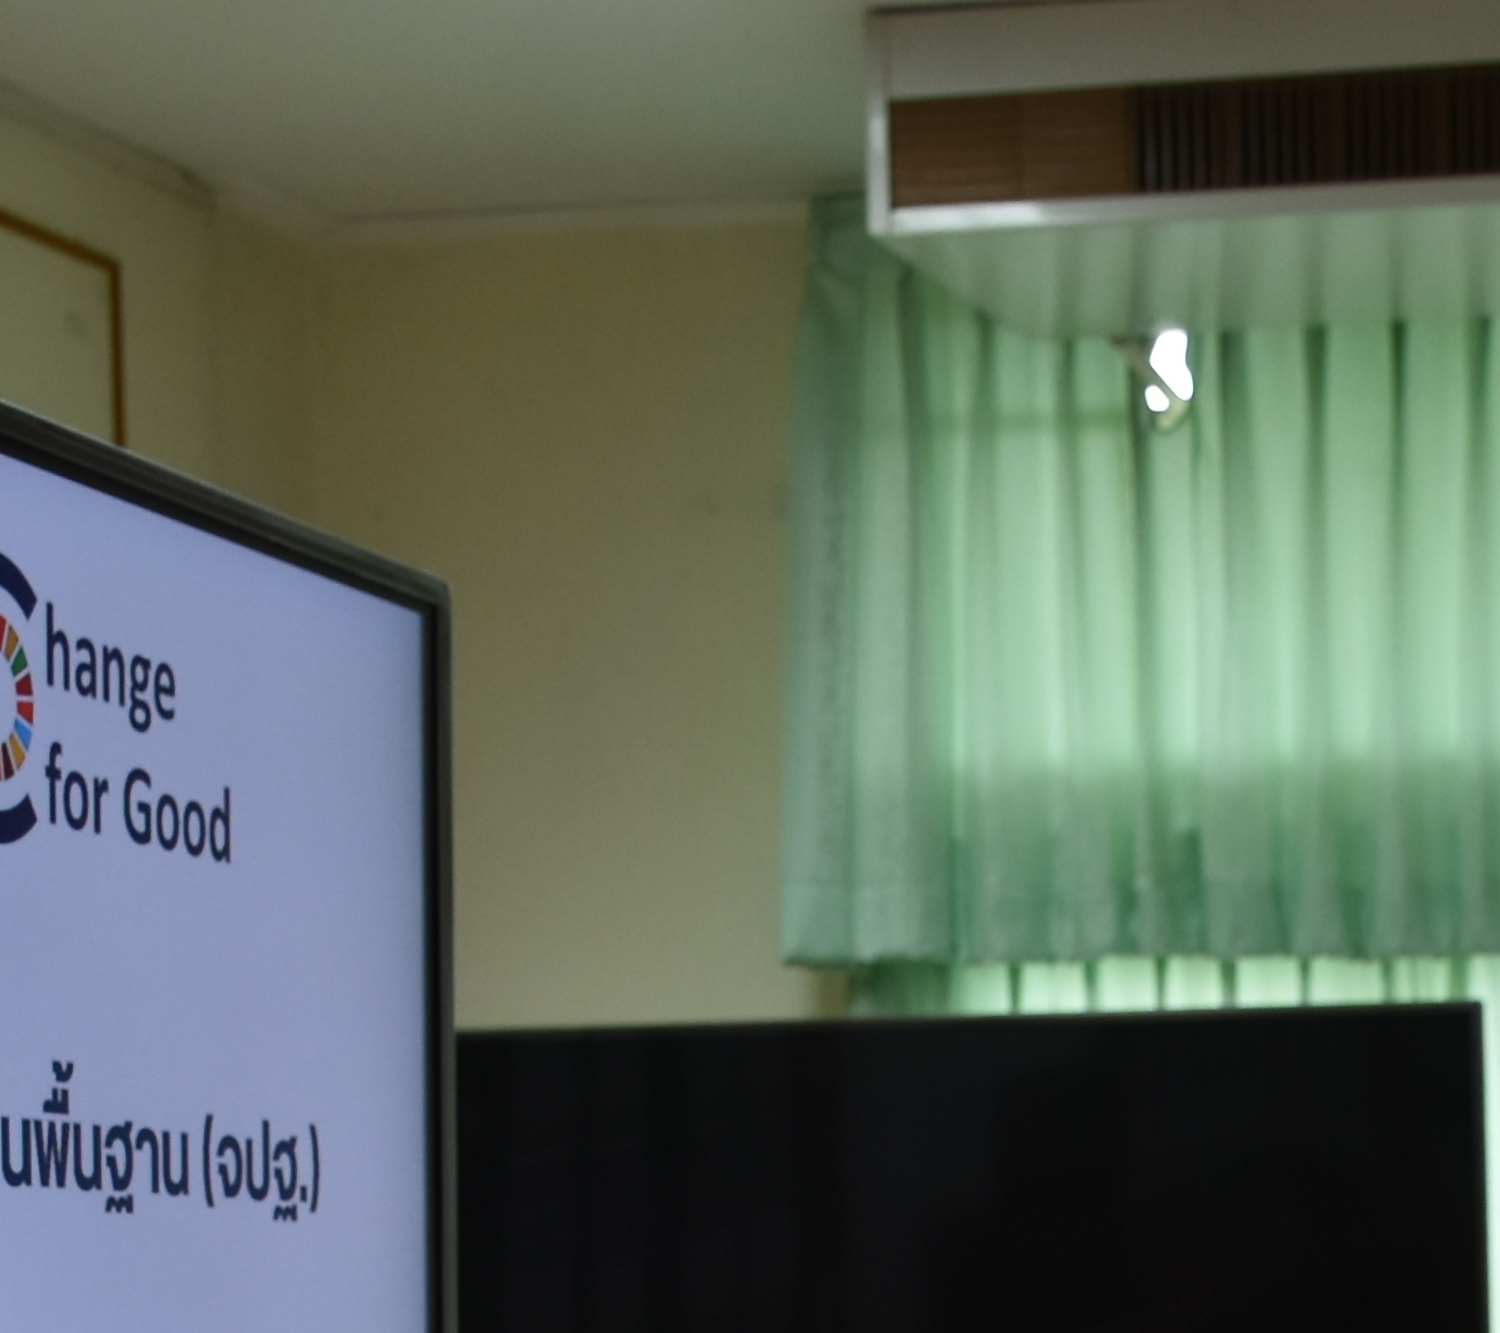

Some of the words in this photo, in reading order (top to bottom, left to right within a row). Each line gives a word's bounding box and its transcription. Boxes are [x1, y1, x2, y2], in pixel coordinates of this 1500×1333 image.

[44, 741, 110, 835] for
[122, 767, 232, 865] Good
[201, 1112, 321, 1223] (จปฐ.)
